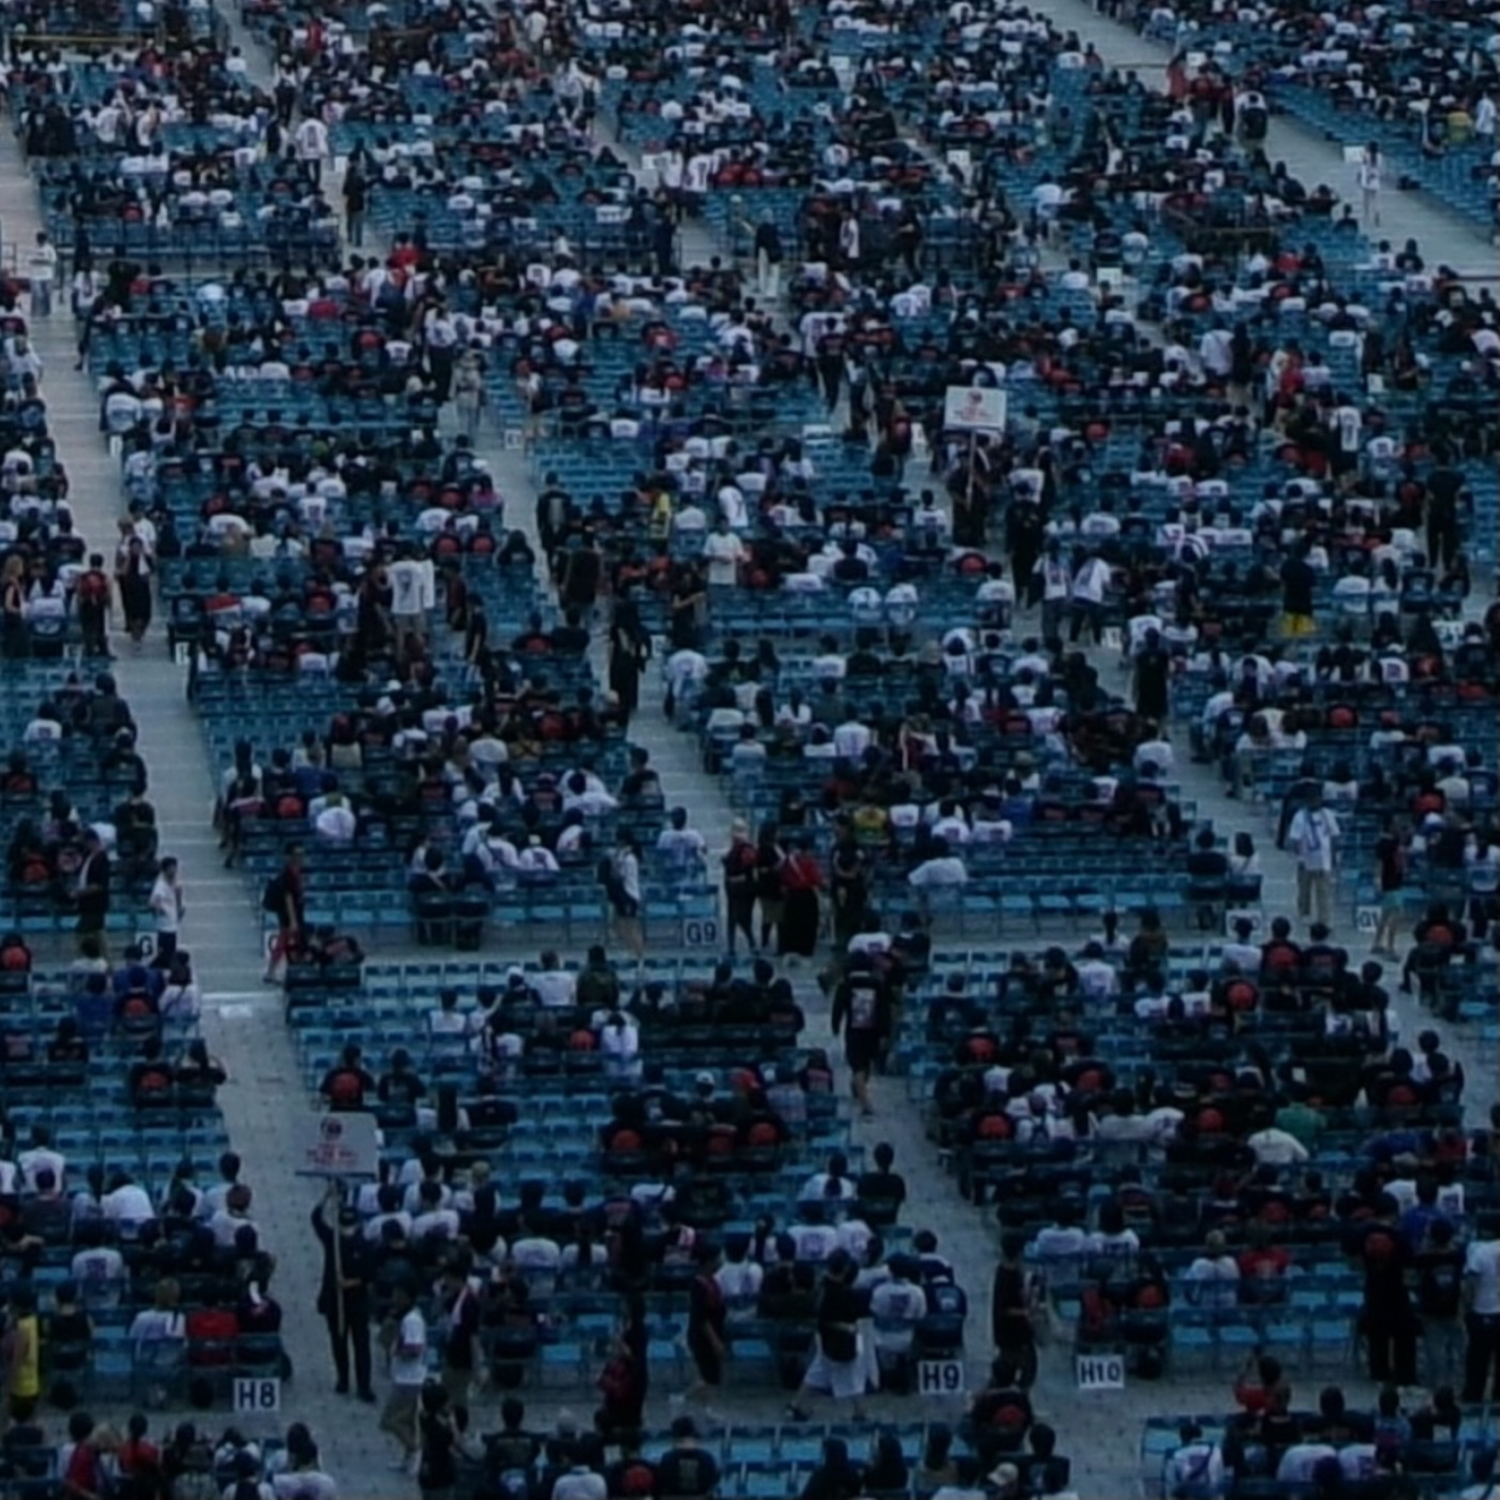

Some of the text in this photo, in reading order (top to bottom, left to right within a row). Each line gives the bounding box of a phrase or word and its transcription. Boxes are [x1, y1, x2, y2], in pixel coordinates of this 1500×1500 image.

[687, 921, 717, 942] G9
[923, 1364, 960, 1392] H9
[1079, 1362, 1120, 1386] H10
[238, 1381, 276, 1410] H8
